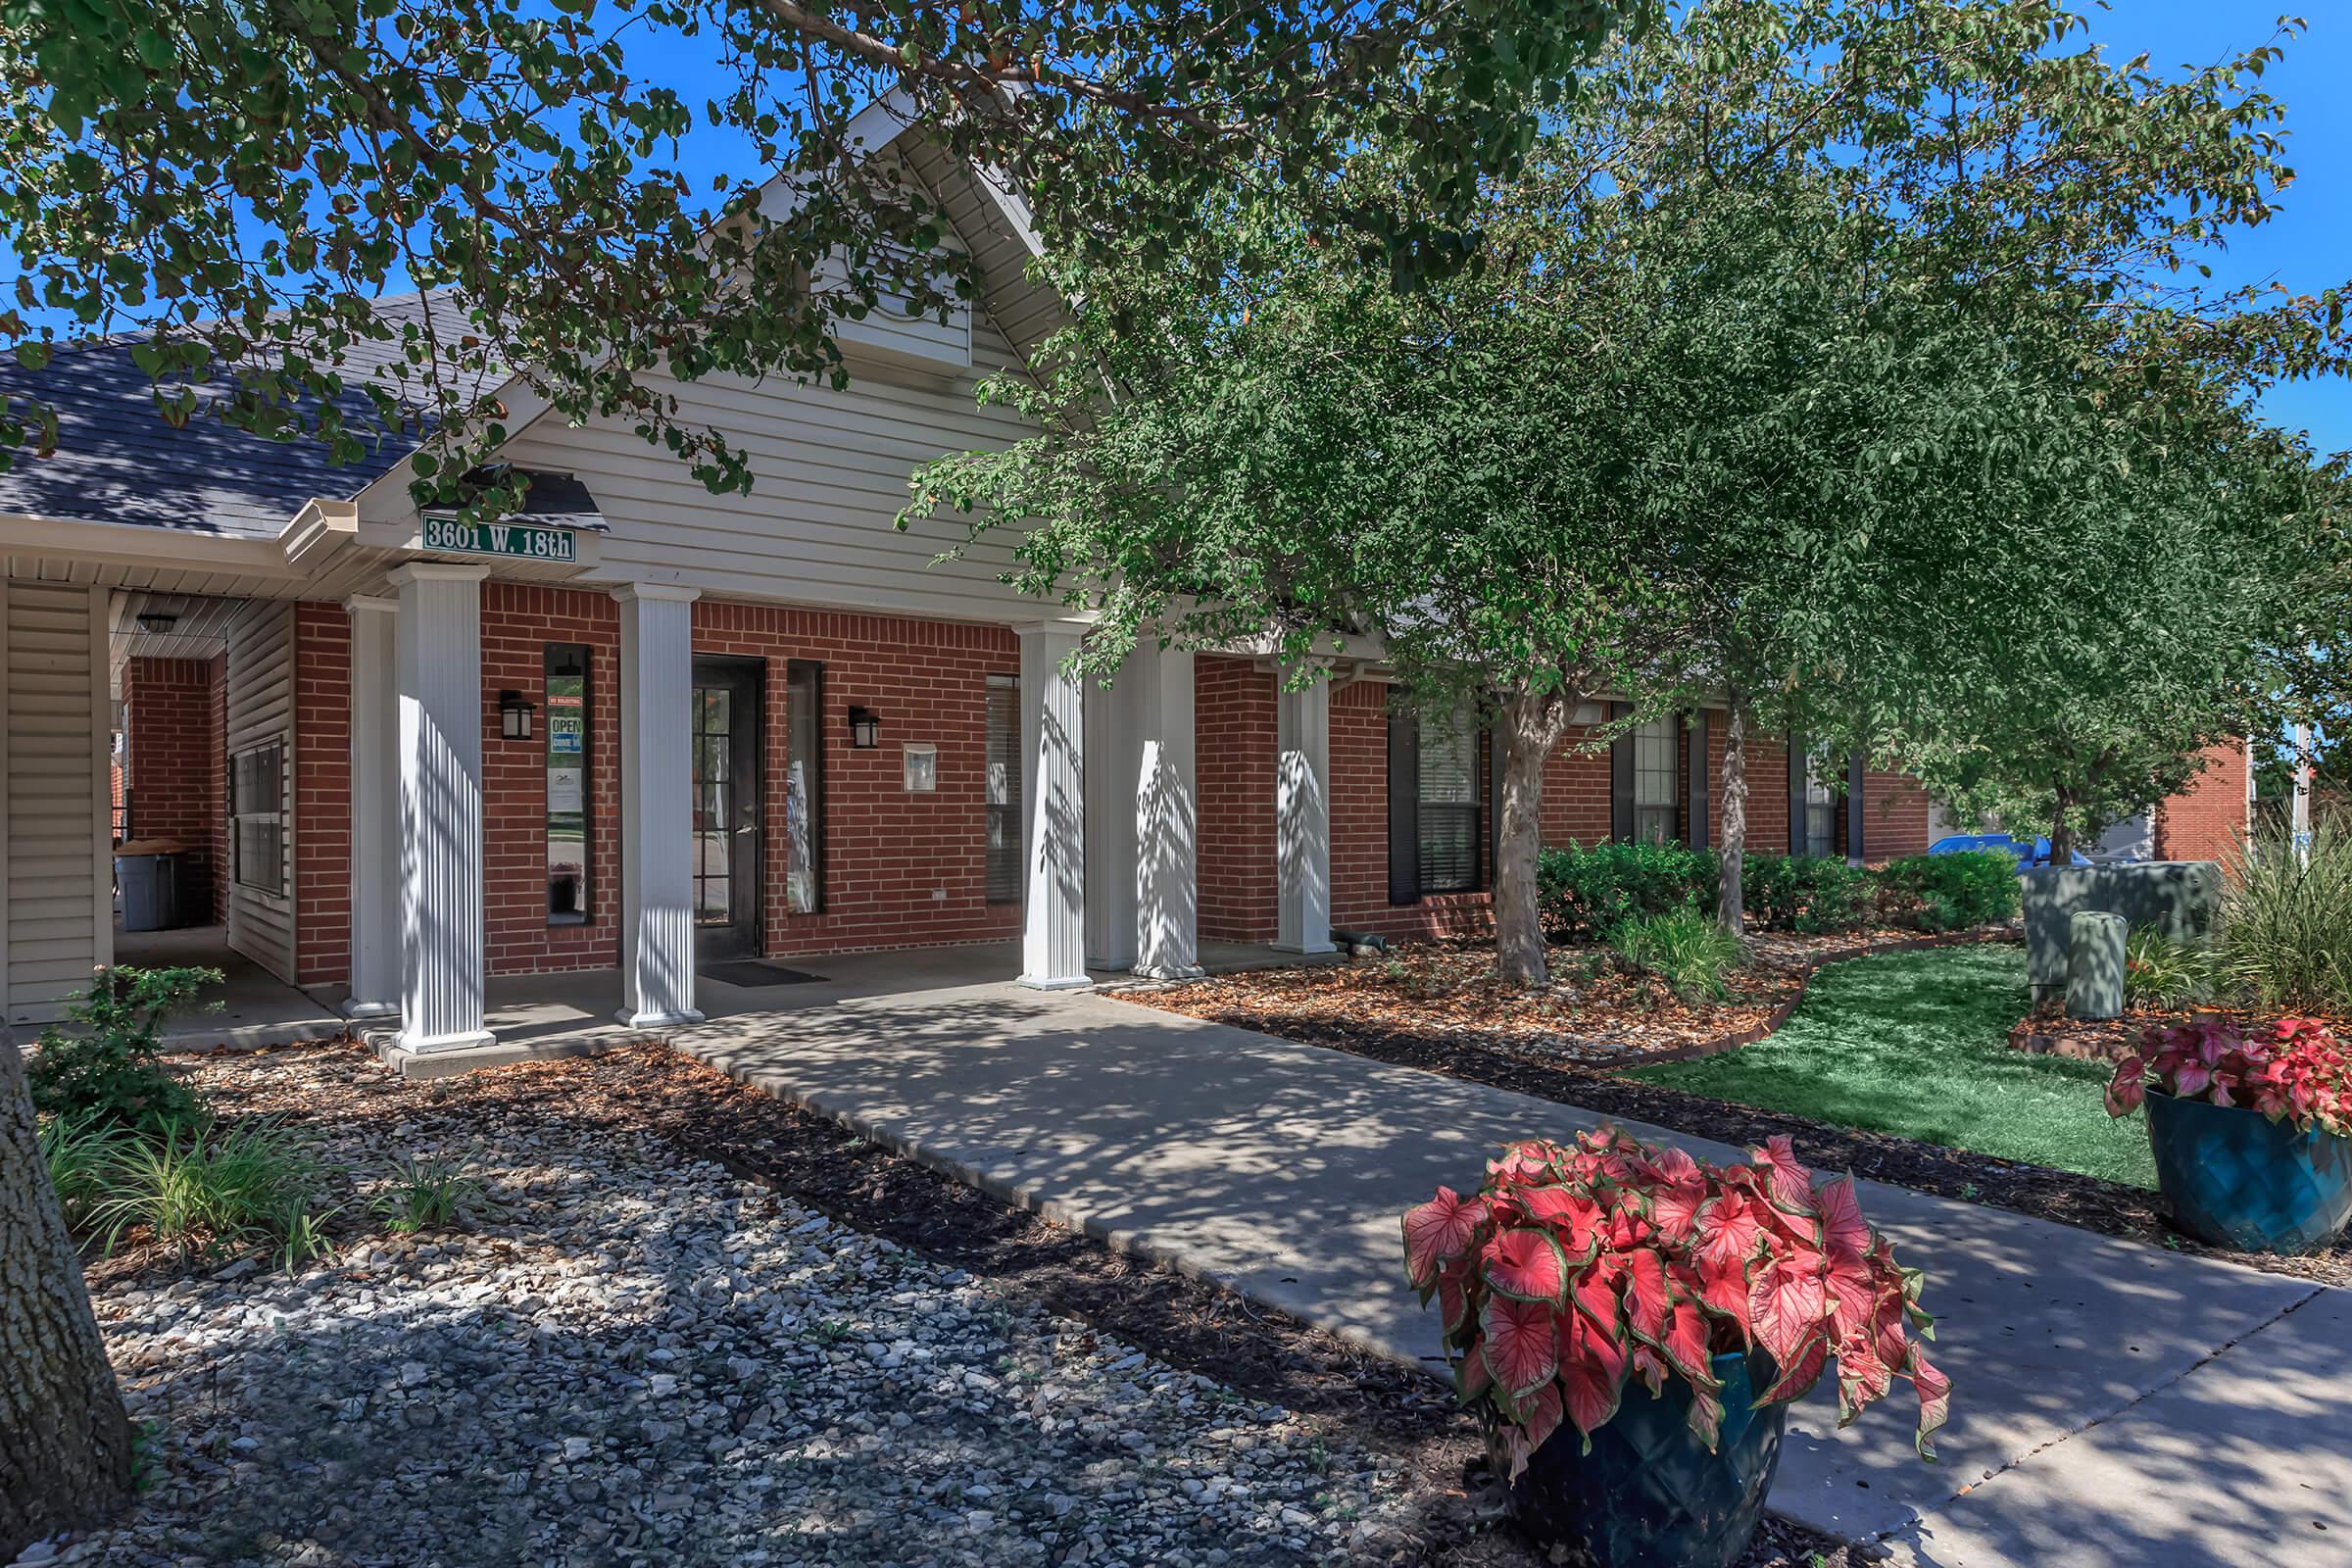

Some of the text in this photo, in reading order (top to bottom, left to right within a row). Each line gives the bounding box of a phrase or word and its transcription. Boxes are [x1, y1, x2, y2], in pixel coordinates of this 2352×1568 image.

[428, 520, 570, 558] 3601 W. 18th
[553, 719, 581, 733] OPEN
